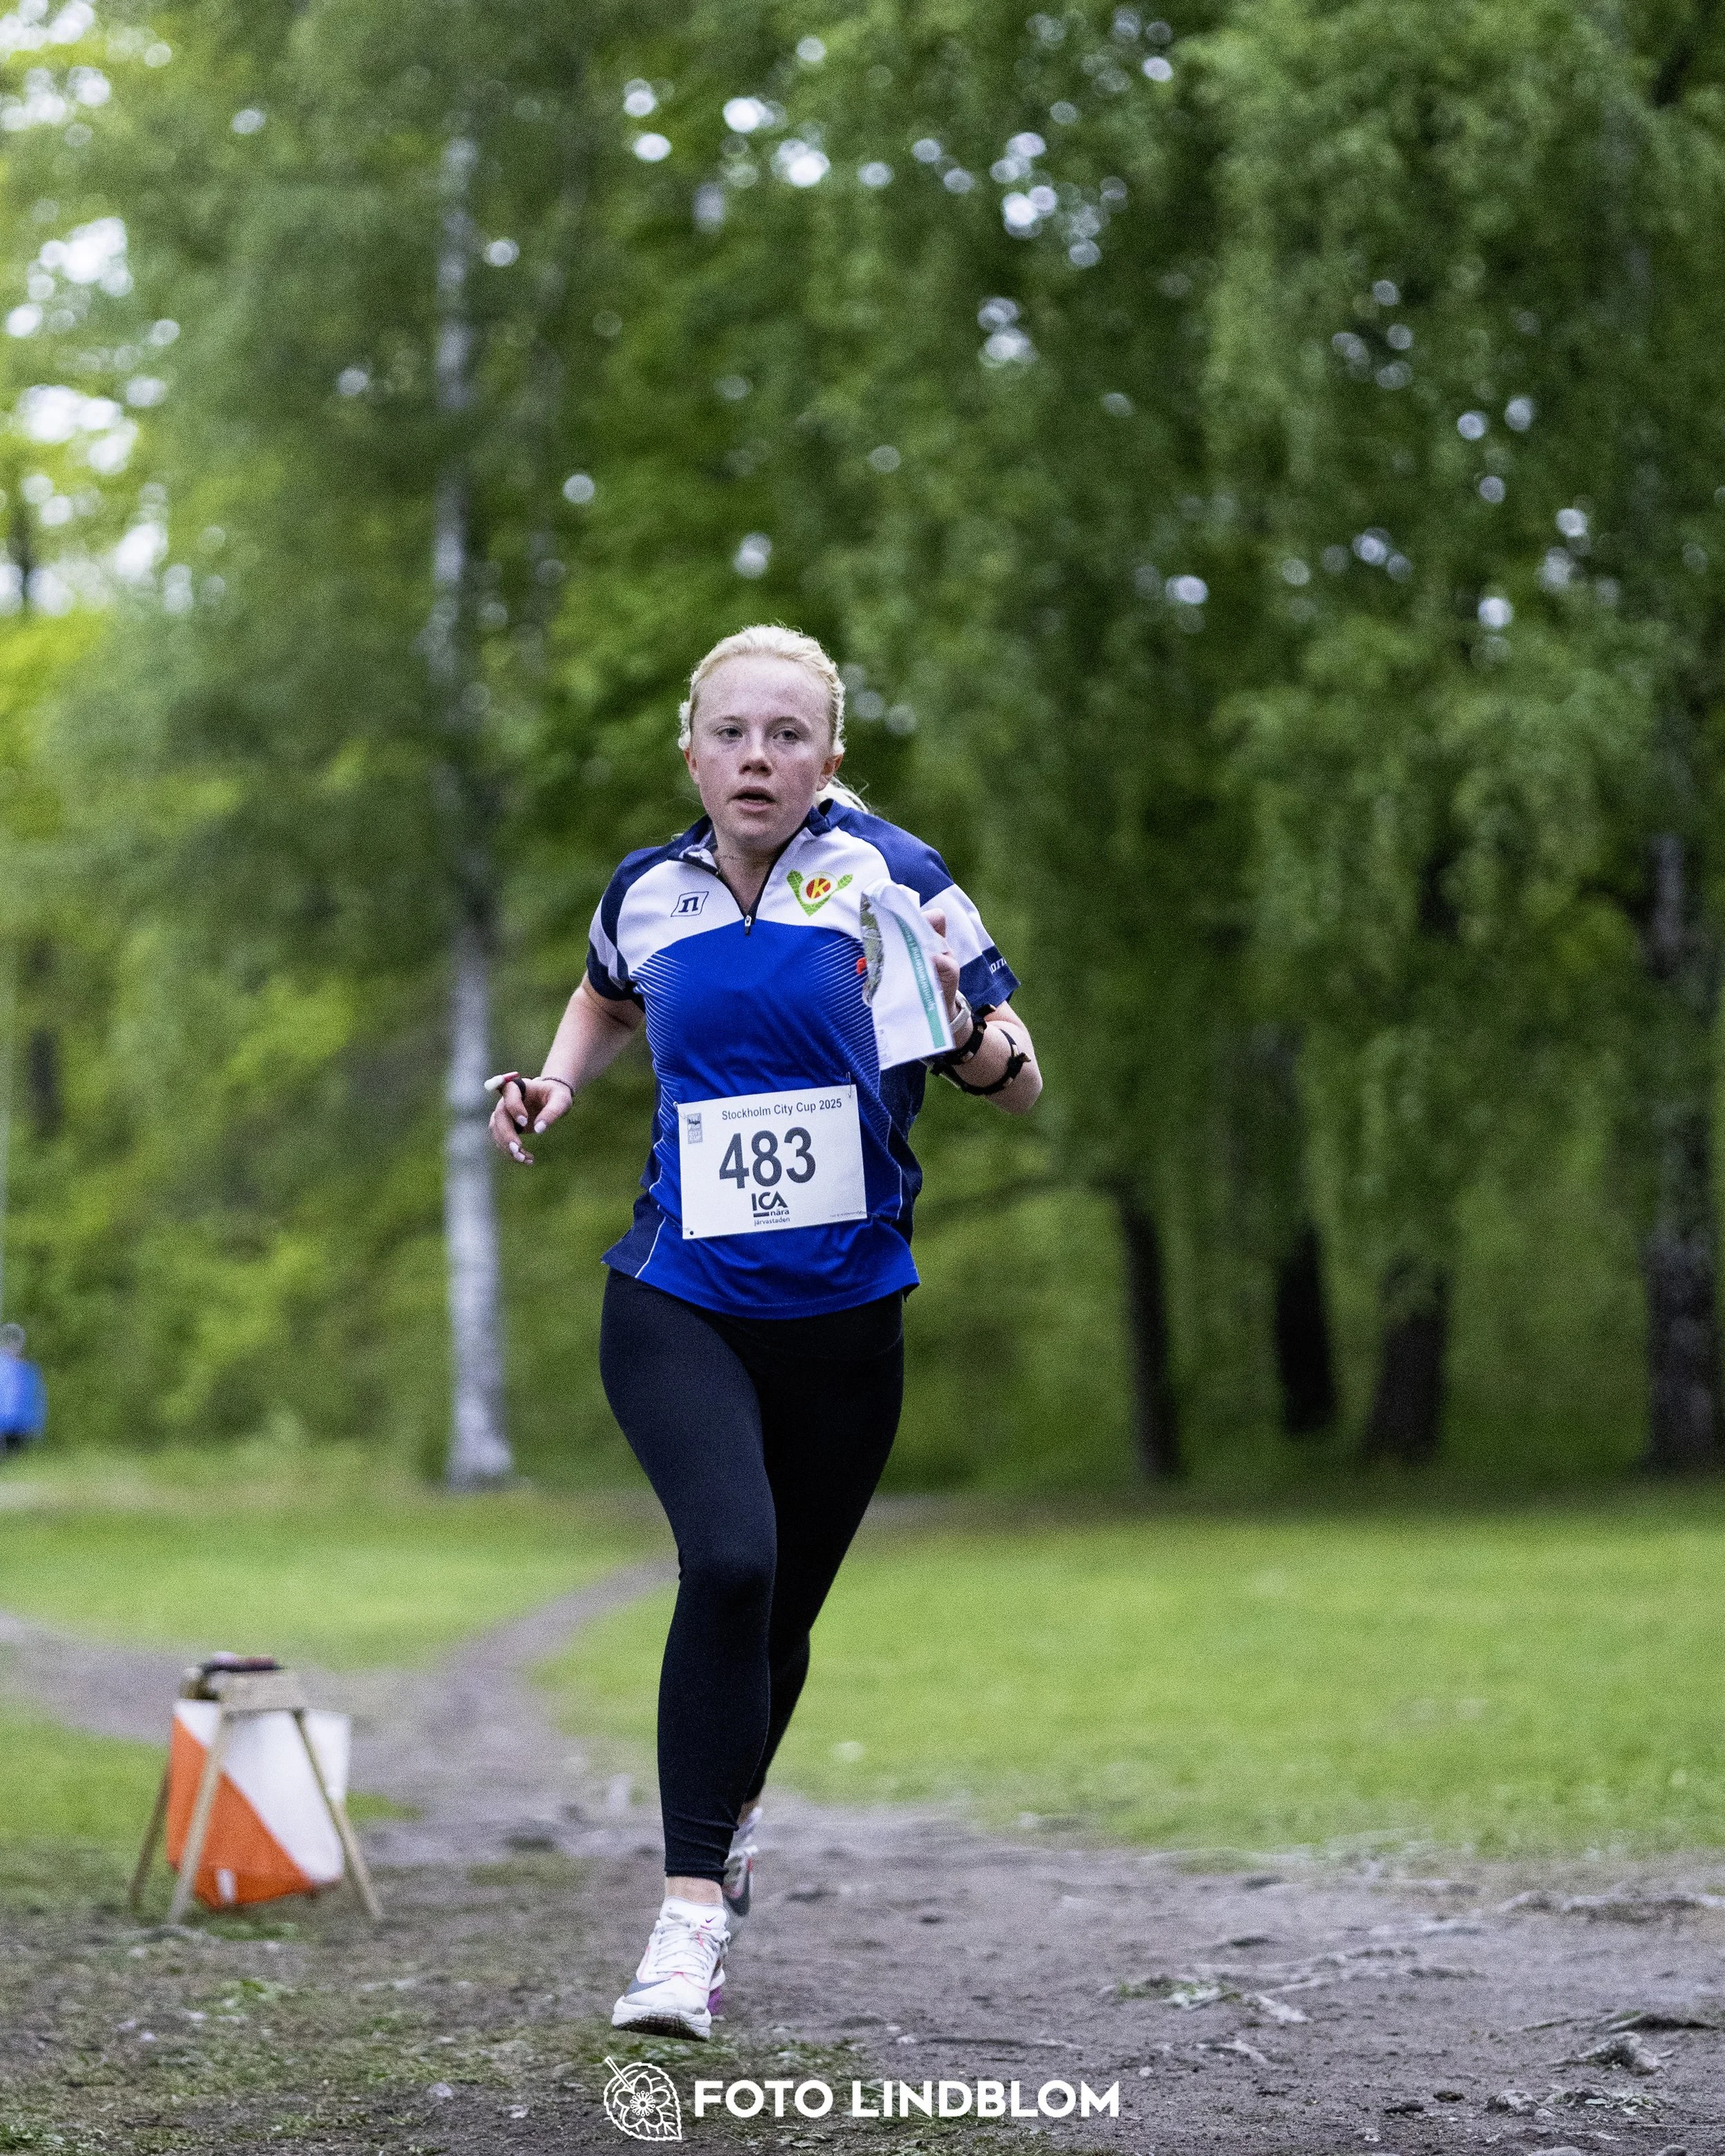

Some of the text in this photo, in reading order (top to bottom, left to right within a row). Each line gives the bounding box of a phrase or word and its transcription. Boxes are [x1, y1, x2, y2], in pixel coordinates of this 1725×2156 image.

[810, 878, 831, 900] K
[722, 1098, 842, 1120] Stockholm City Cup 2025
[719, 1127, 816, 1189] 483
[751, 1190, 788, 1211] ICA
[770, 1208, 790, 1216] nära
